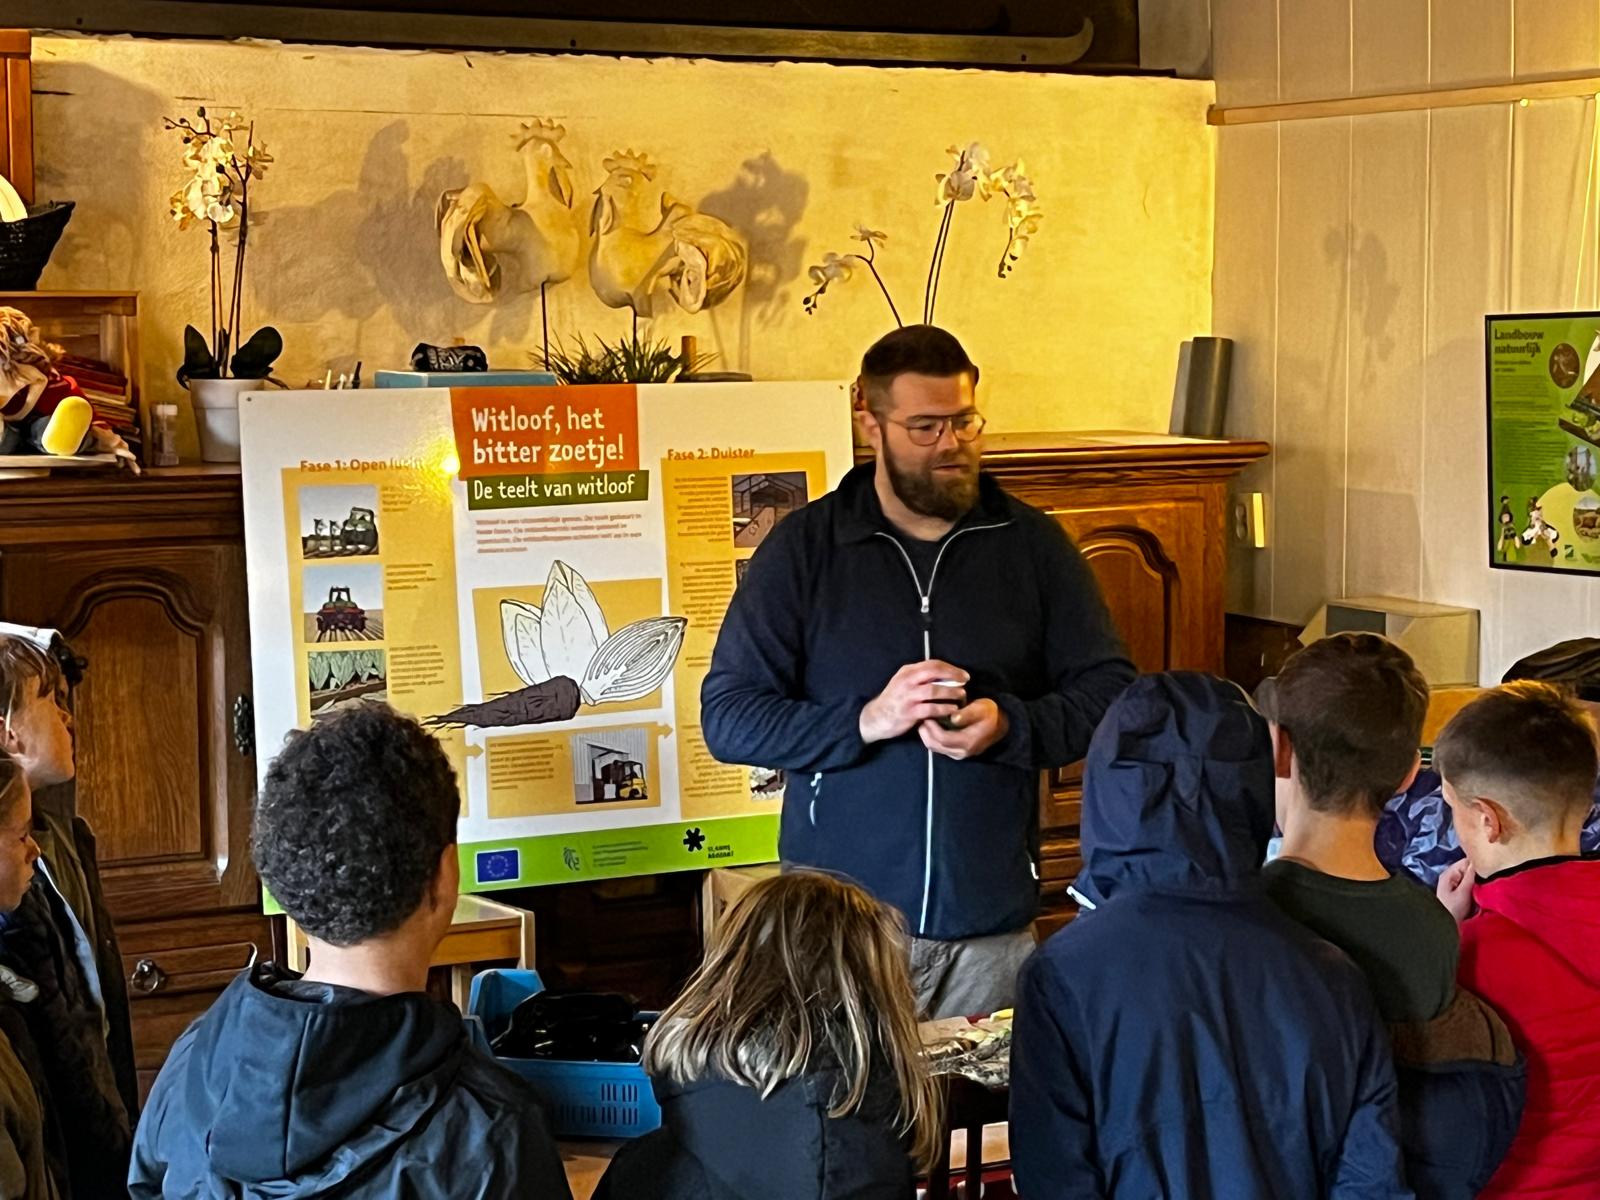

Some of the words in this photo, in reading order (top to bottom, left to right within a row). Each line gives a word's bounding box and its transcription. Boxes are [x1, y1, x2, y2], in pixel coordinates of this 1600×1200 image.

[1494, 328, 1544, 340] Landbouw
[471, 405, 560, 434] Witloof,
[567, 405, 604, 430] het
[473, 438, 541, 464] bitter
[549, 433, 624, 468] zoetje!
[667, 449, 694, 461] Fase
[711, 447, 755, 460] Duister
[300, 460, 331, 472] Fase
[334, 459, 347, 471] 1:
[350, 458, 387, 473] Open
[474, 479, 493, 500] De
[498, 476, 538, 498] teelt
[544, 483, 572, 497] van
[577, 474, 635, 496] witloof
